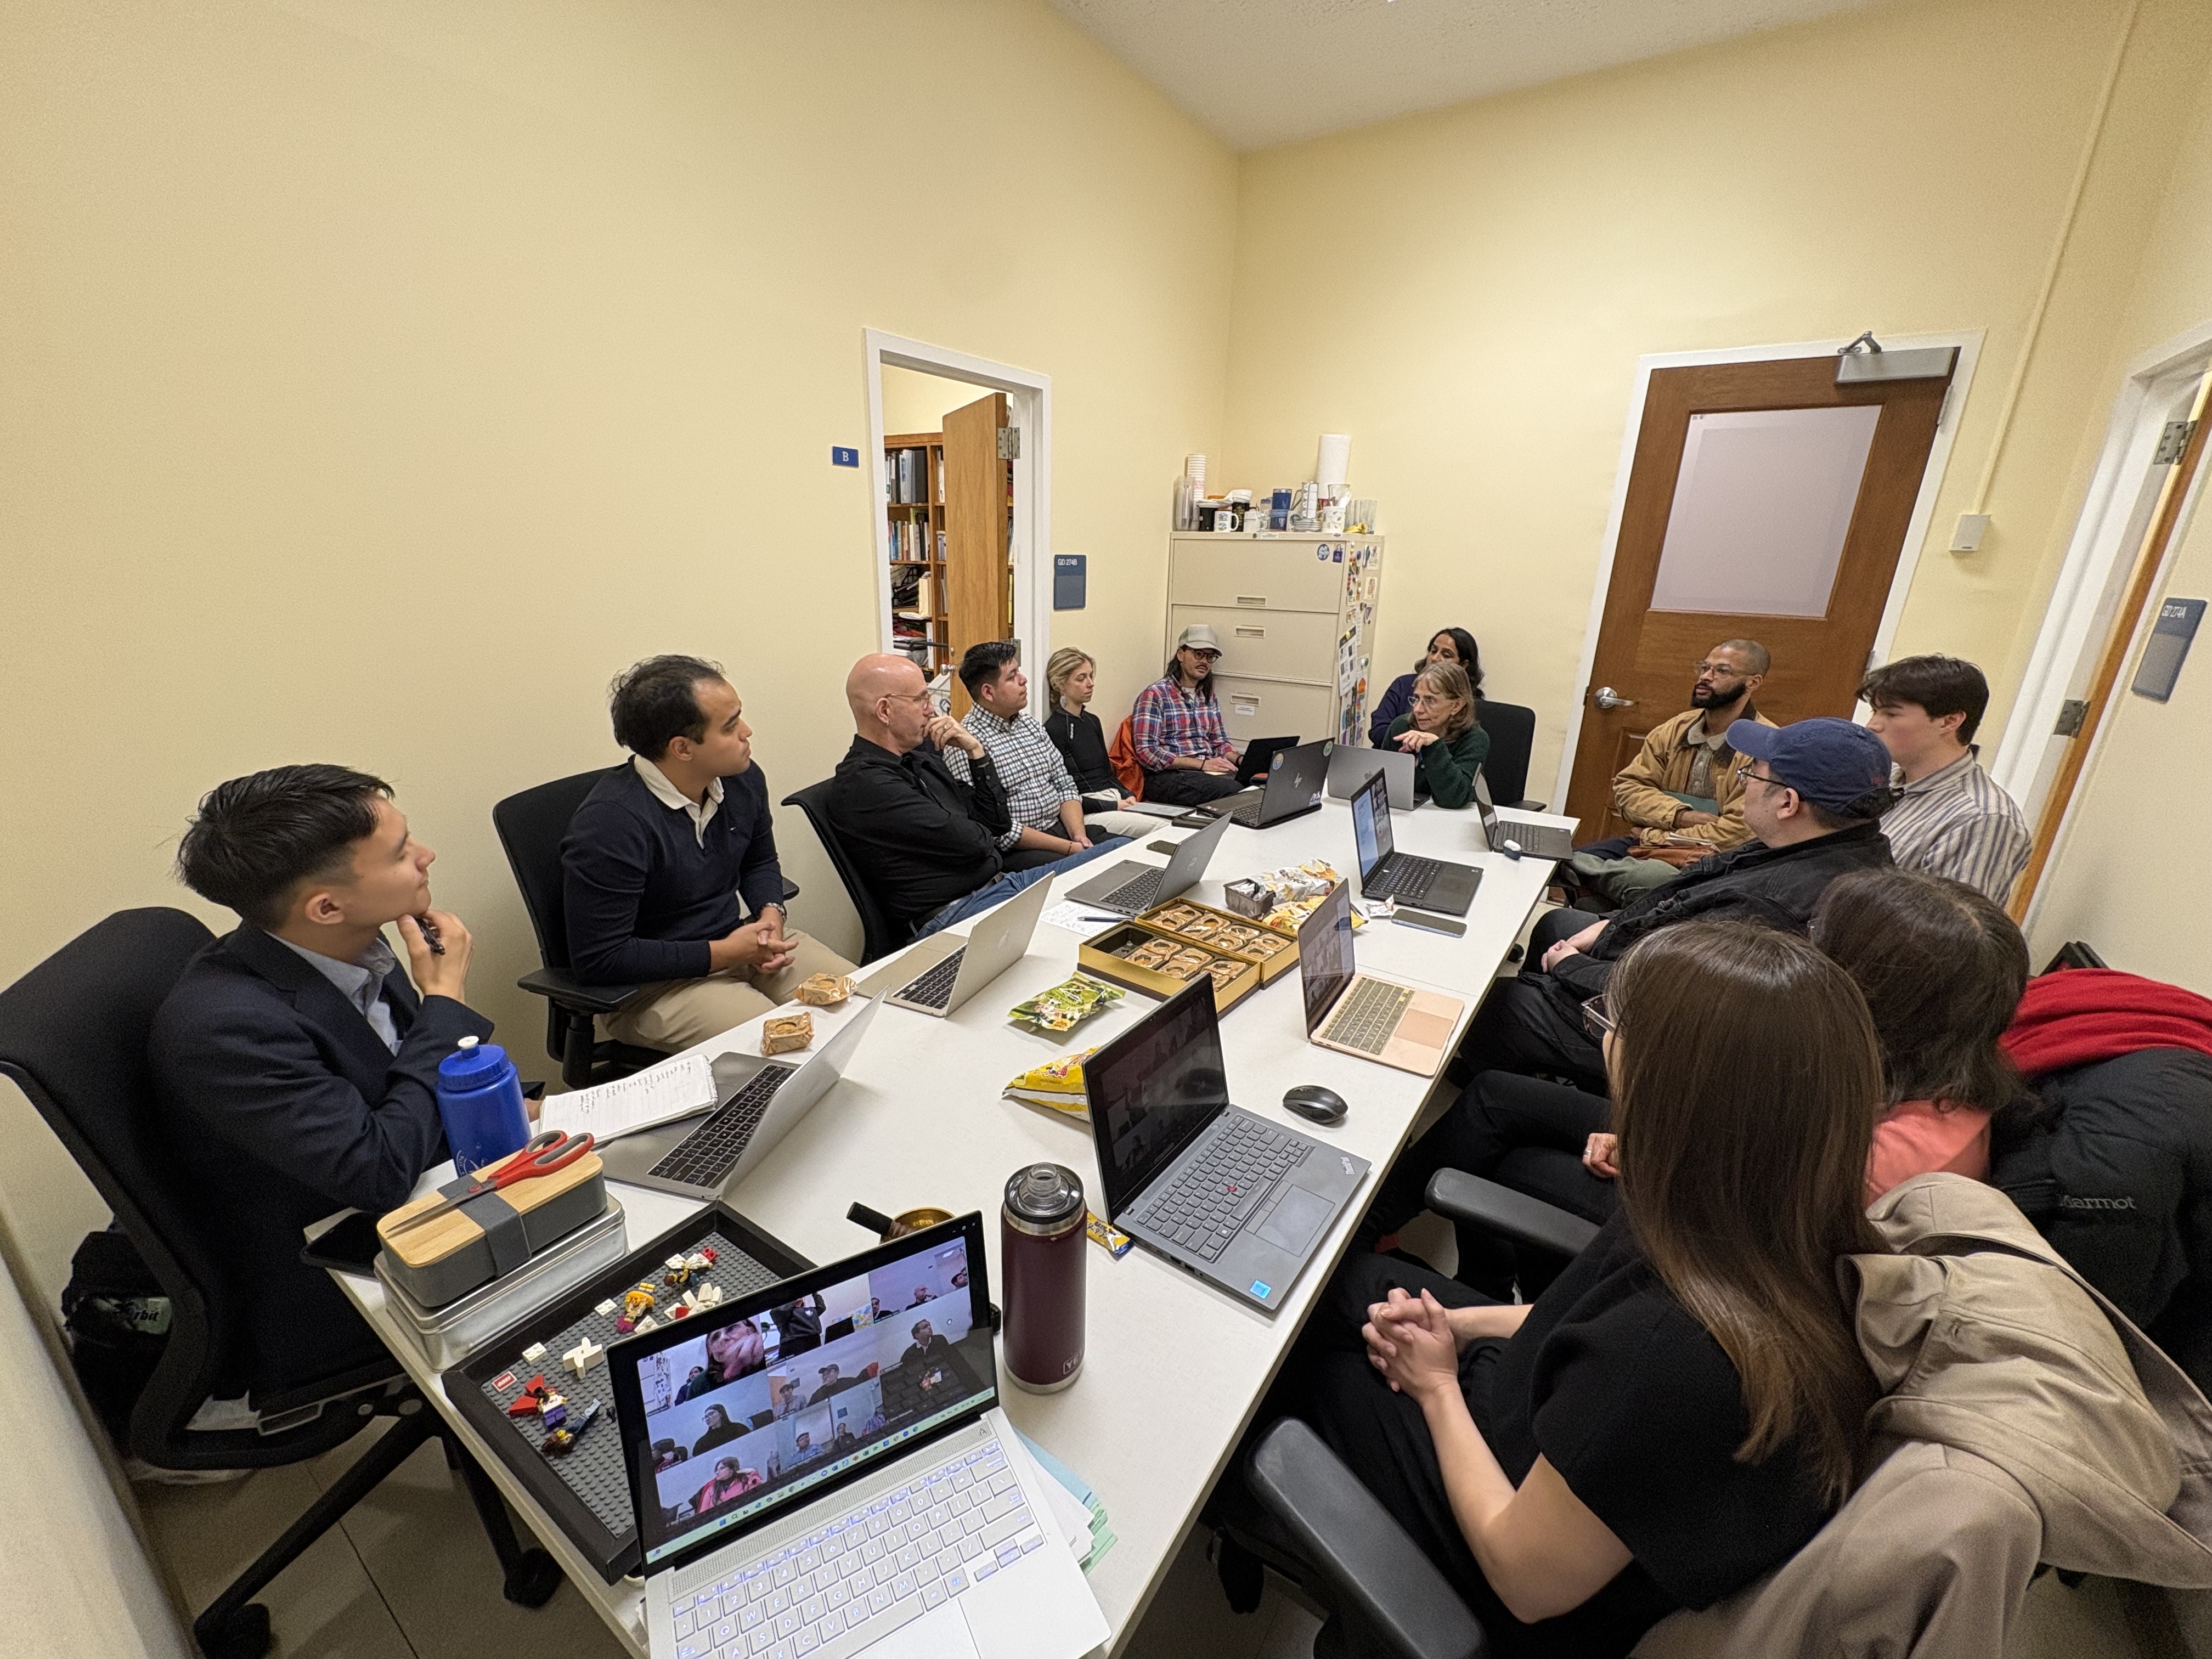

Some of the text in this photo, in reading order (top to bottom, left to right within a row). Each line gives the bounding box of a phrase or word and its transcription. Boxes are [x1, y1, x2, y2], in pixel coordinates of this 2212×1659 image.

[842, 451, 849, 461] B
[133, 1309, 160, 1321] rbit
[720, 1626, 730, 1635] Q
[746, 1610, 756, 1622] W
[774, 1598, 780, 1608] E
[798, 1585, 805, 1594] R
[869, 1546, 876, 1555] U
[732, 1647, 740, 1658] A
[759, 1632, 766, 1642] S
[785, 1618, 792, 1628] D
[810, 1604, 816, 1614] F
[833, 1591, 842, 1600] G
[857, 1578, 866, 1588] H
[904, 1553, 911, 1561] K
[802, 1635, 810, 1645] C
[827, 1620, 834, 1630] V
[853, 1607, 860, 1617] B
[876, 1593, 884, 1604] N
[899, 1580, 908, 1591] M
